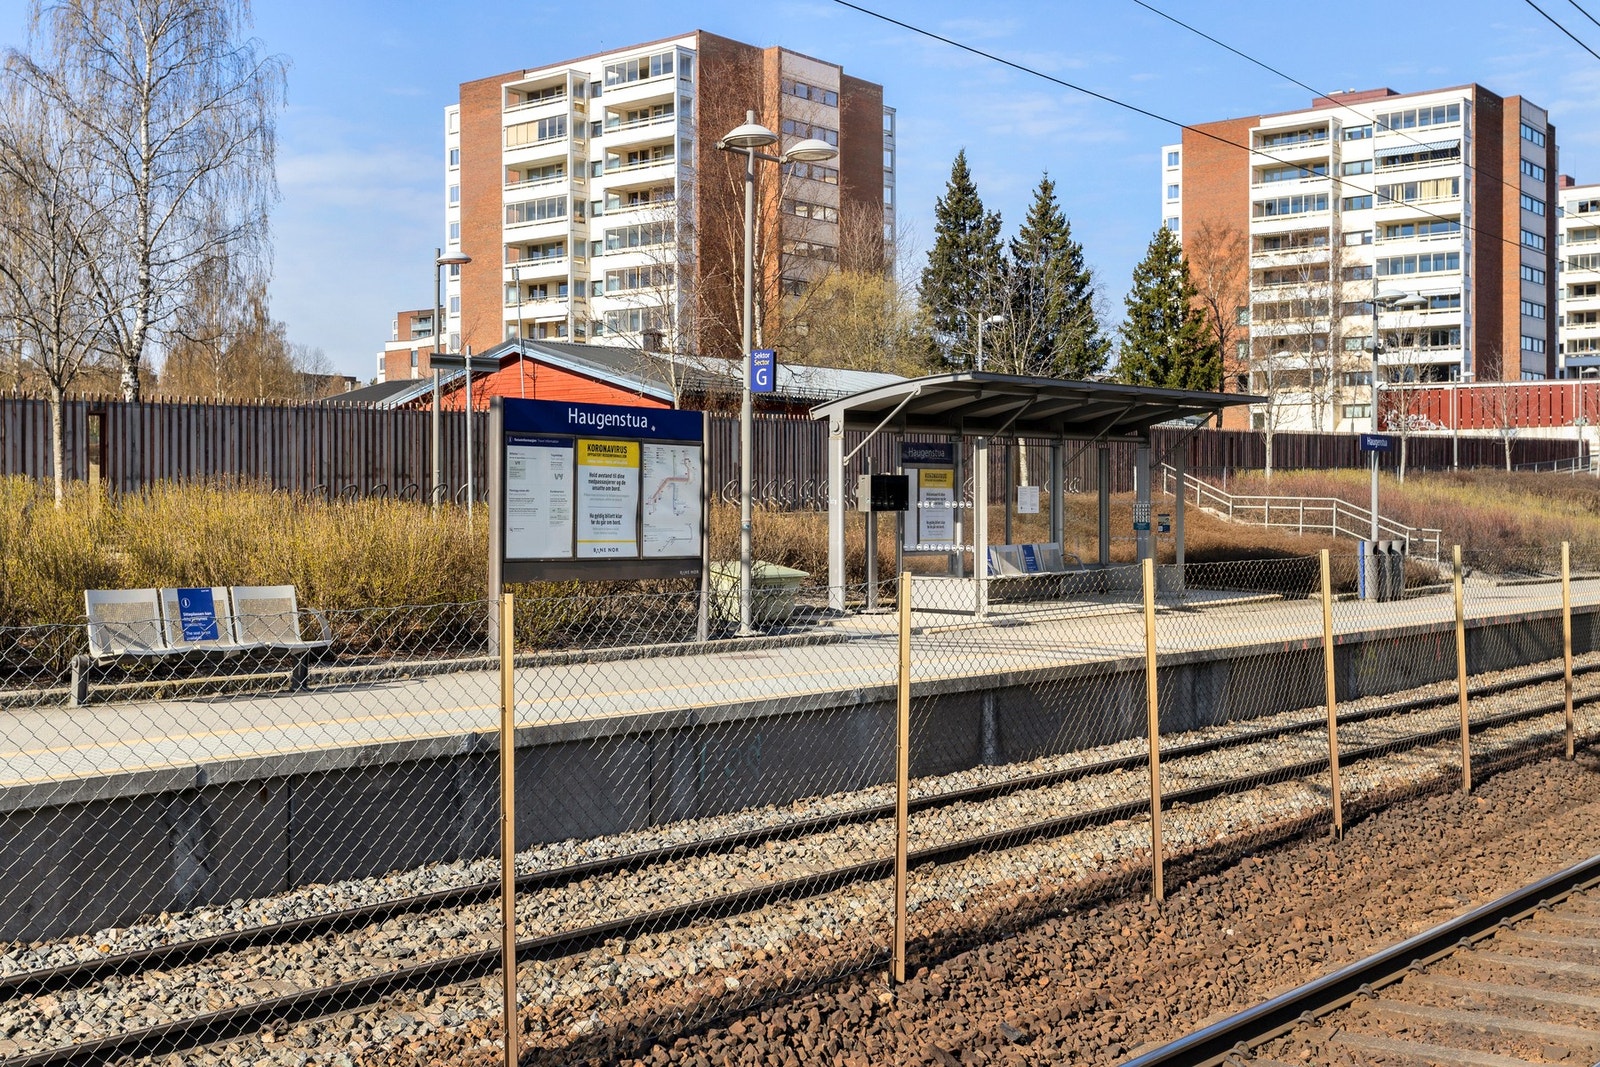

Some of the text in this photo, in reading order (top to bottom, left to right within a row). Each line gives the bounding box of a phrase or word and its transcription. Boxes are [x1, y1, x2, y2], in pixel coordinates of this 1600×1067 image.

[756, 368, 767, 386] G
[568, 408, 648, 430] Haugenstua
[1366, 436, 1388, 448] Haugenstua
[587, 444, 628, 454] KORONAVIRUS
[908, 448, 945, 459] Haugenstua
